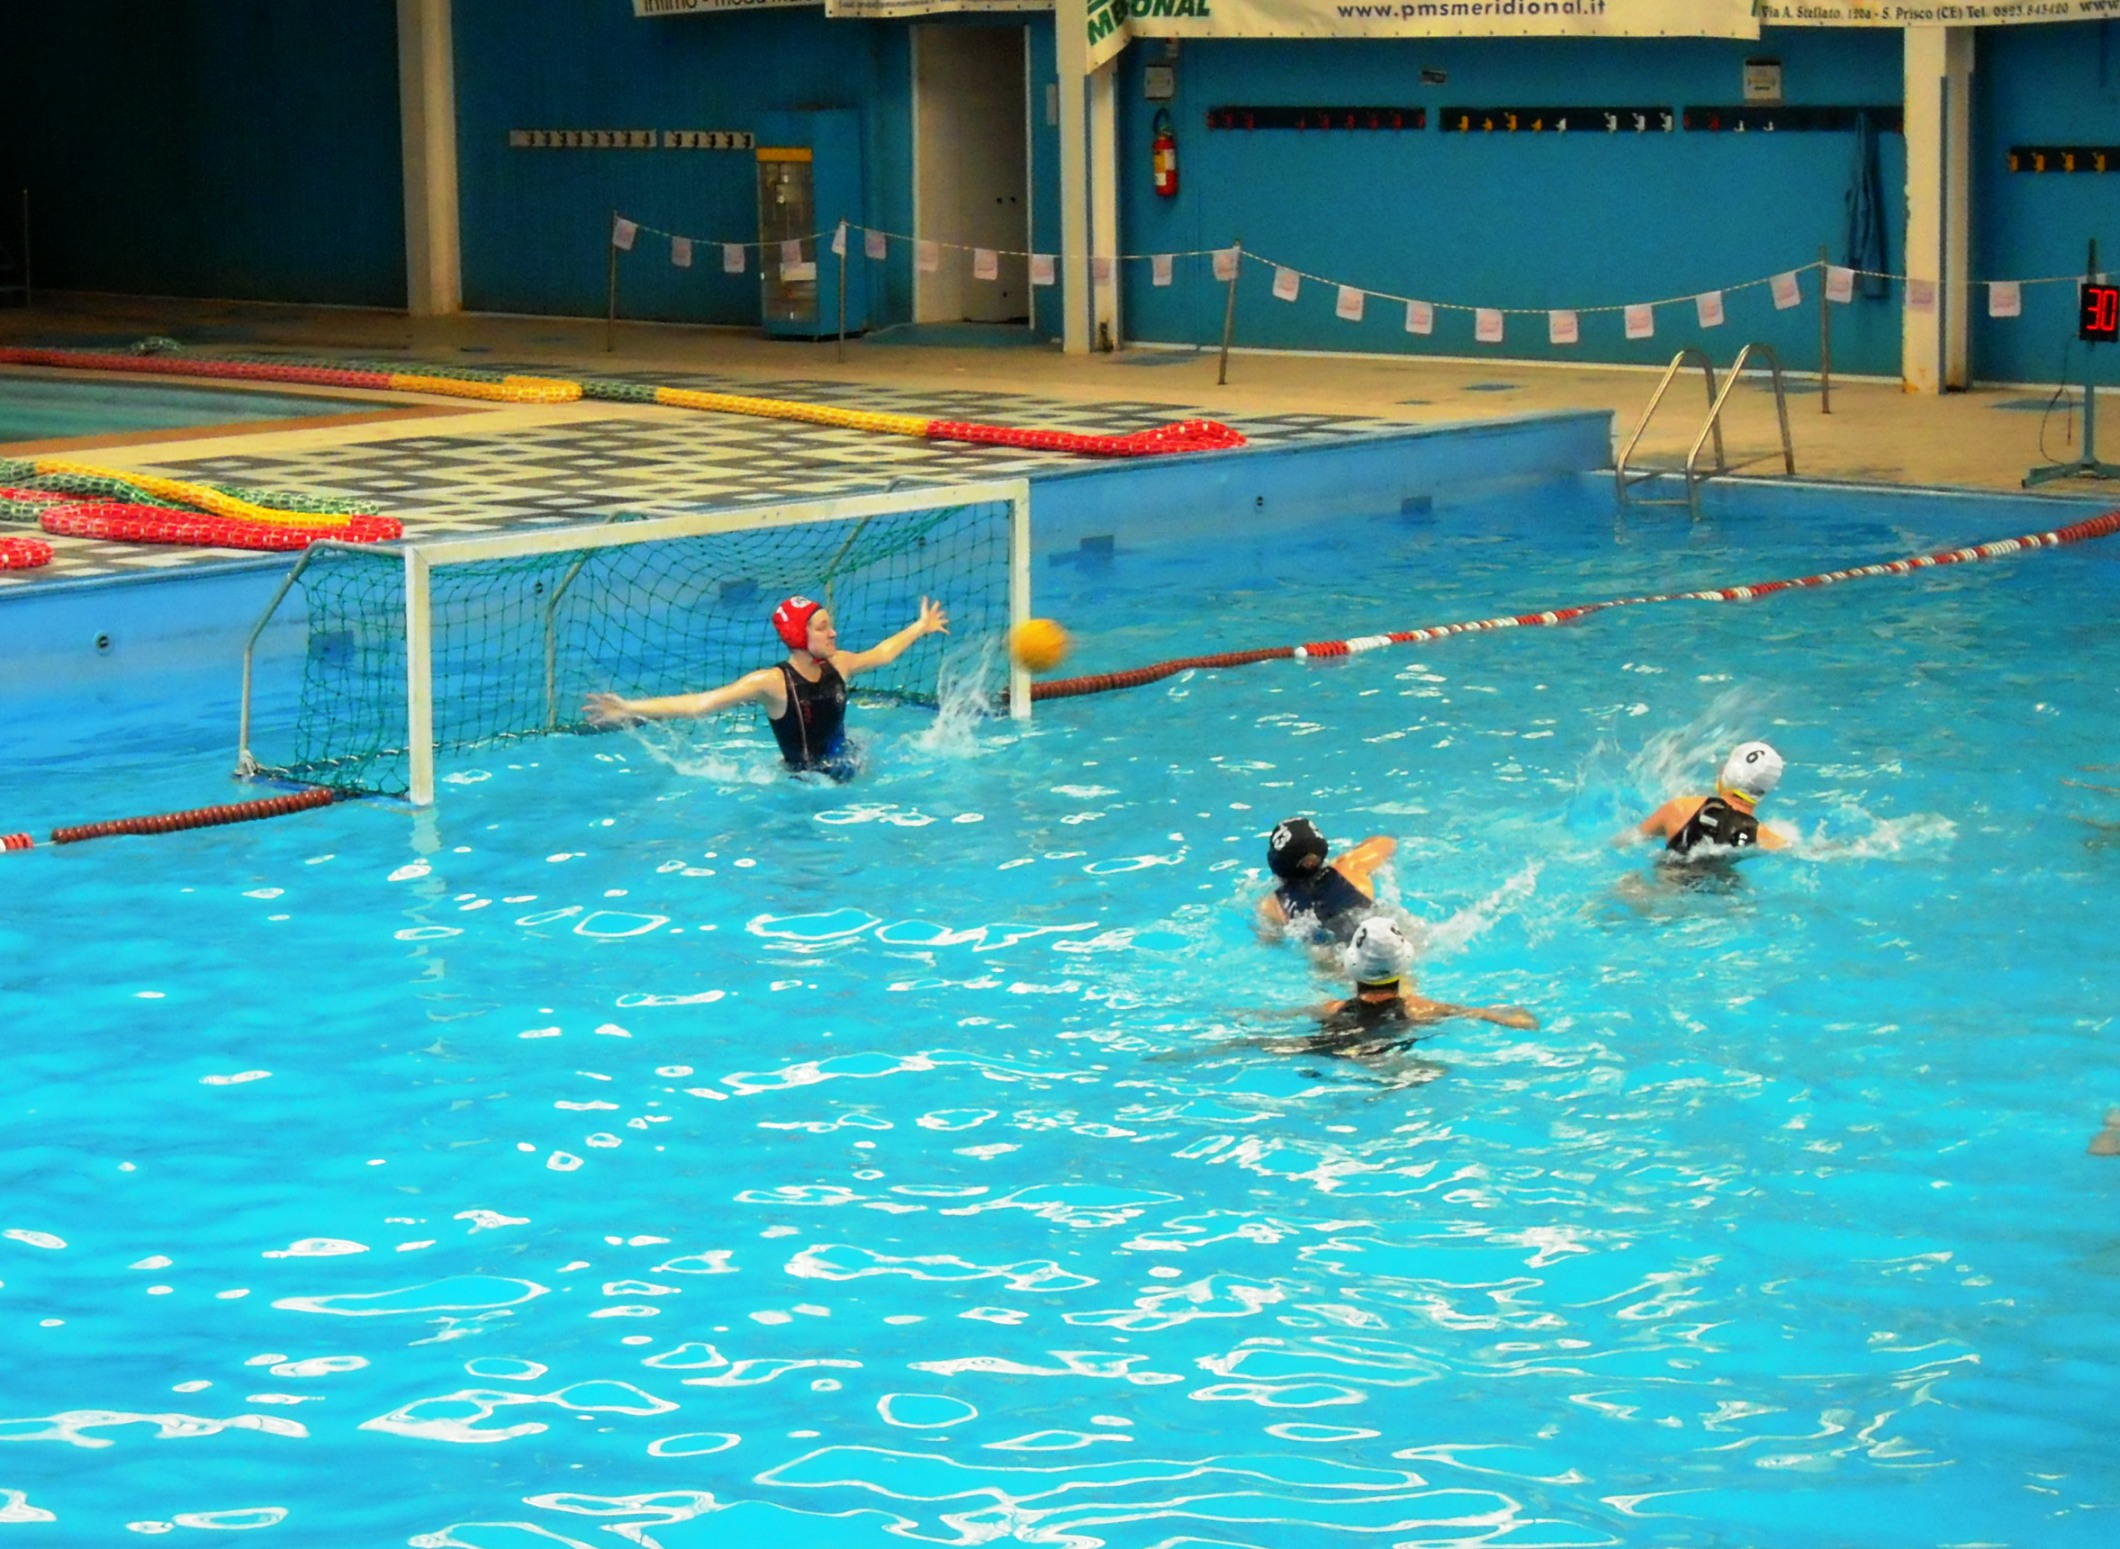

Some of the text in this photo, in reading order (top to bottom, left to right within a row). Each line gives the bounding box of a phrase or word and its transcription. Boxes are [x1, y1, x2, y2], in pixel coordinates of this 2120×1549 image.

[1337, 0, 1605, 21] www.pmsmeridional.it
[1896, 7, 1933, 19] Prisco
[1936, 6, 1962, 19] (CE)
[2085, 288, 2117, 331] 30
